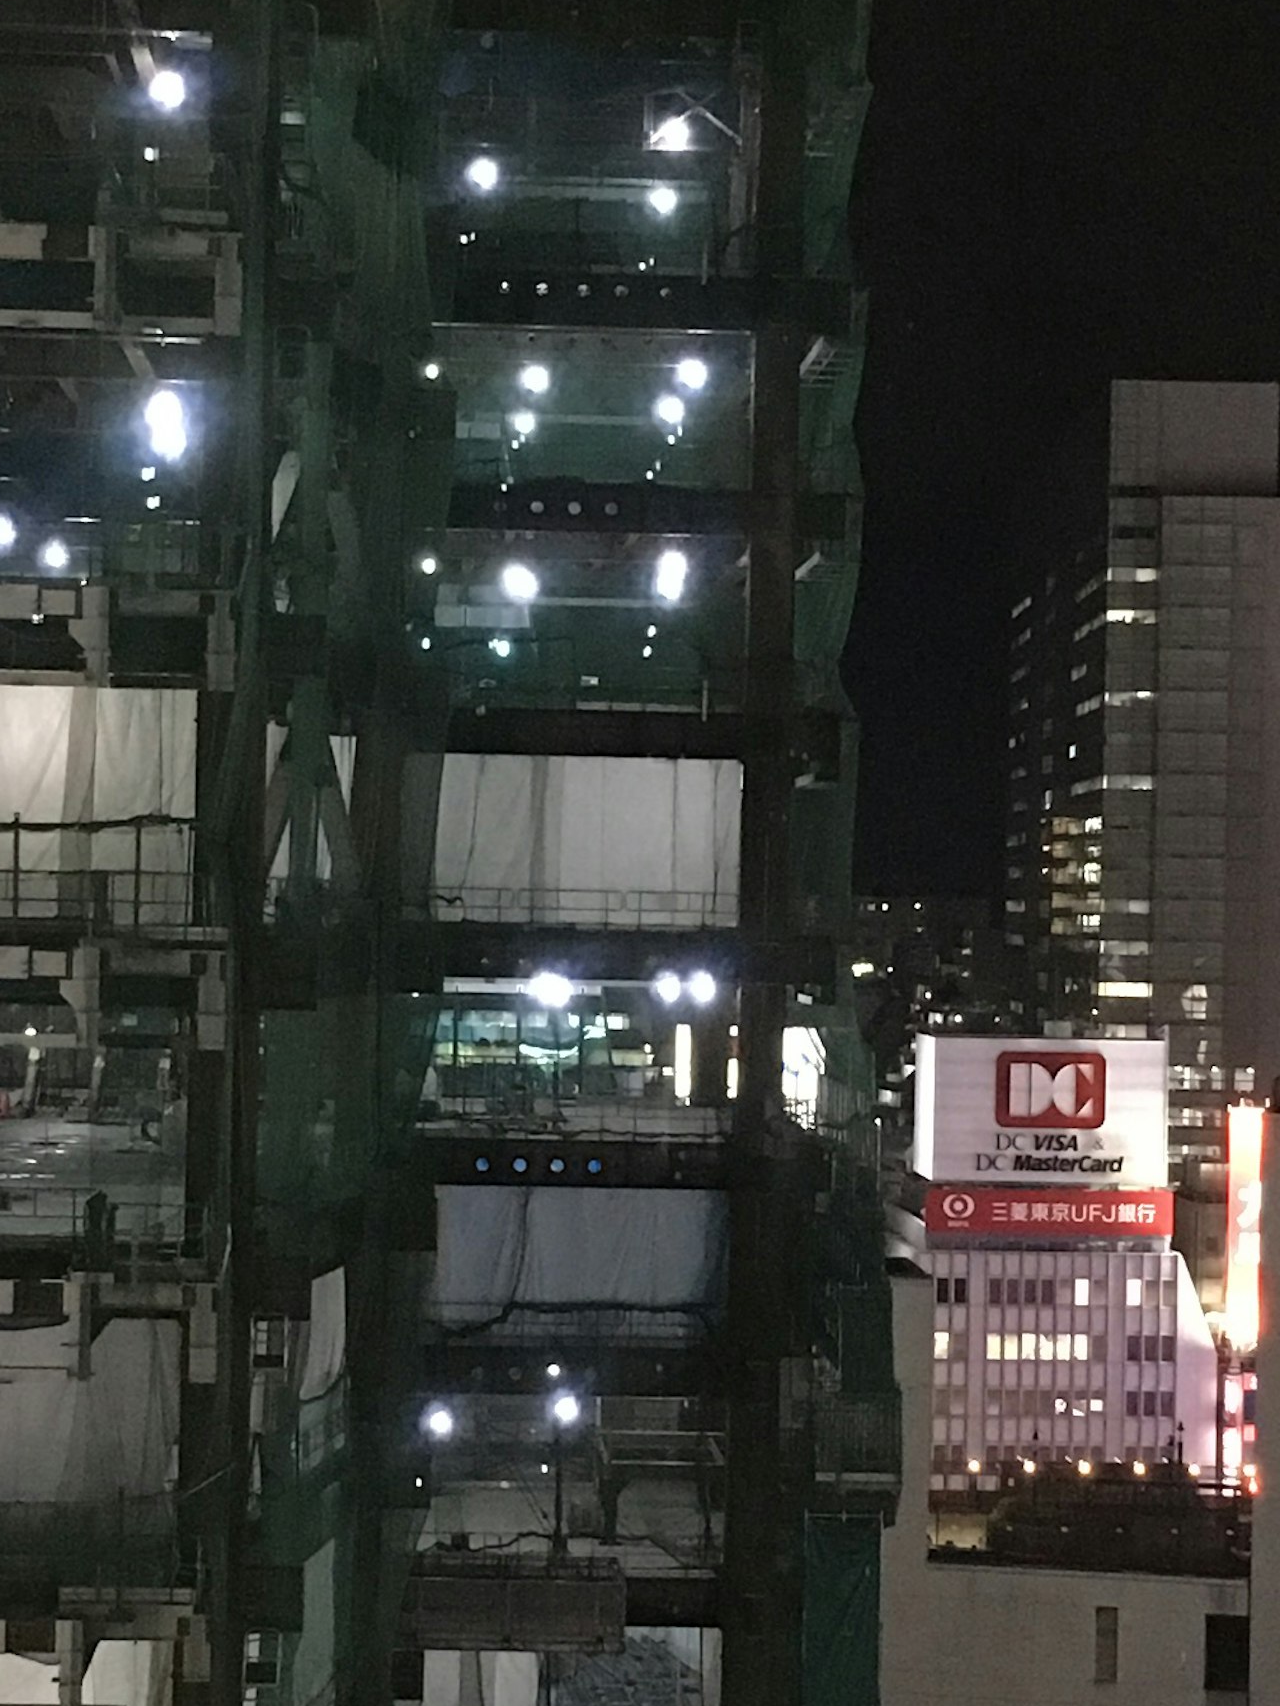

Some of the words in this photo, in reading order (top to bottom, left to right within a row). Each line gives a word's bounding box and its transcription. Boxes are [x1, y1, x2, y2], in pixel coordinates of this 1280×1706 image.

[1008, 1062, 1095, 1118] DC
[995, 1134, 1026, 1151] DC
[1033, 1135, 1079, 1151] VISA
[1091, 1138, 1105, 1150] &
[975, 1154, 1007, 1172] DC
[1012, 1155, 1124, 1173] MasterCard
[991, 1201, 1157, 1225] 三菱東京UFJ銀行
